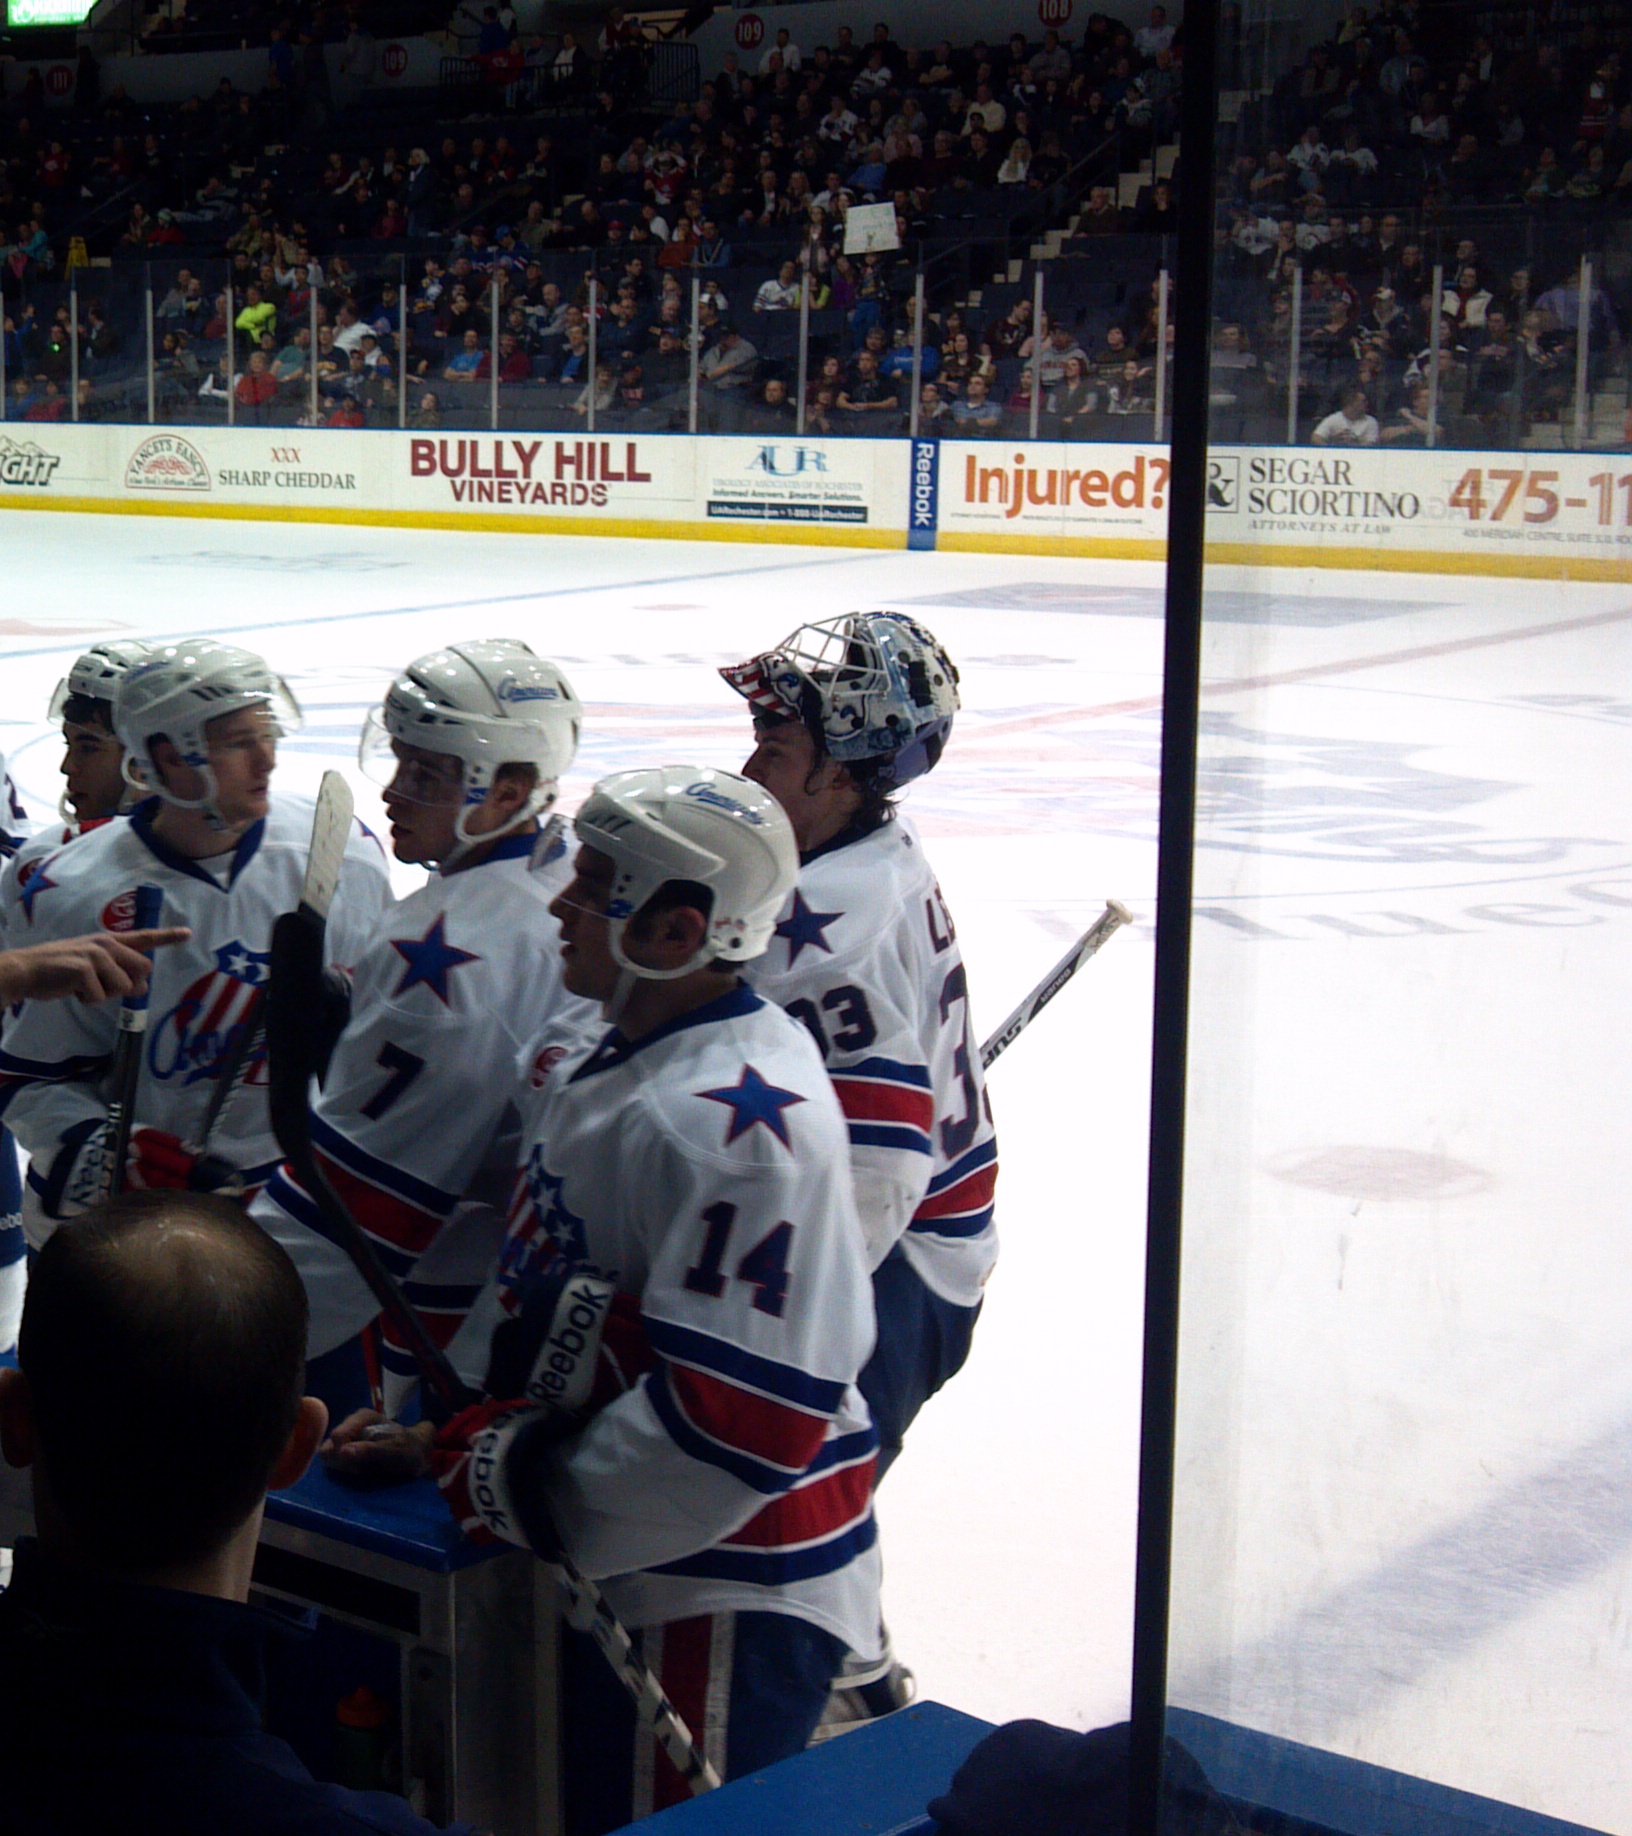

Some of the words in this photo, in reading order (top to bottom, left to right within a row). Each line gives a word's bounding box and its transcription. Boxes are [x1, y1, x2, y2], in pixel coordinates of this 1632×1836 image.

[739, 21, 761, 42] 109
[271, 447, 301, 464] XXX
[411, 438, 543, 479] BULLY
[555, 441, 652, 483] HILL
[1250, 456, 1355, 486] SEGAR
[219, 470, 271, 487] SHARP
[274, 471, 356, 490] CHEDDAR
[450, 479, 608, 507] VINEYARDS
[916, 441, 936, 527] Reebok
[965, 453, 1170, 518] Injured?
[1248, 488, 1421, 519] SCIORTINO
[1248, 519, 1338, 533] ATTORNEYS
[1342, 522, 1361, 534] AT
[1363, 523, 1392, 535] LAW
[361, 1042, 424, 1121] 7
[684, 1198, 796, 1319] 14
[528, 1283, 611, 1403] Reebok
